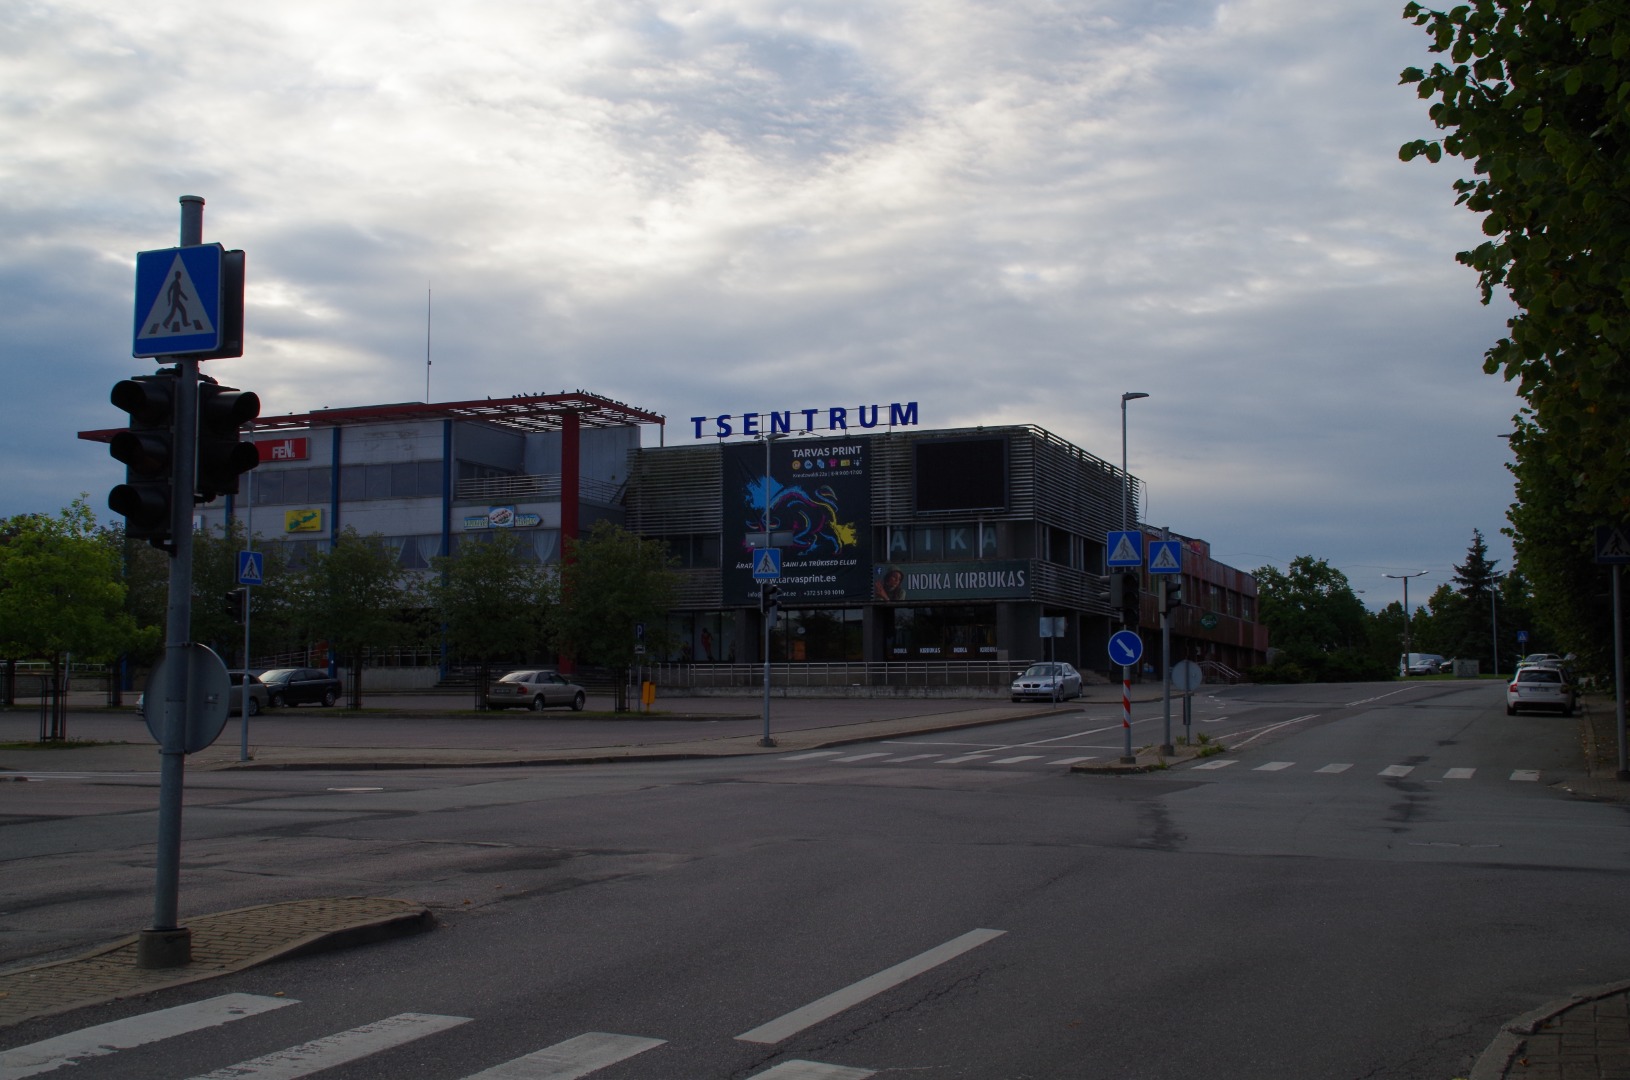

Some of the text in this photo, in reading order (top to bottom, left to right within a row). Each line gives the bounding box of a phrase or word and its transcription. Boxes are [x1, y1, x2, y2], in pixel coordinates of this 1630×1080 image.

[691, 402, 918, 439] TSENTRUM
[792, 445, 862, 458] TARVAS PRINT
[809, 559, 839, 567] TRÜKISED
[908, 570, 1025, 590] INDIKA KIRBUKAS
[637, 624, 643, 639] P
